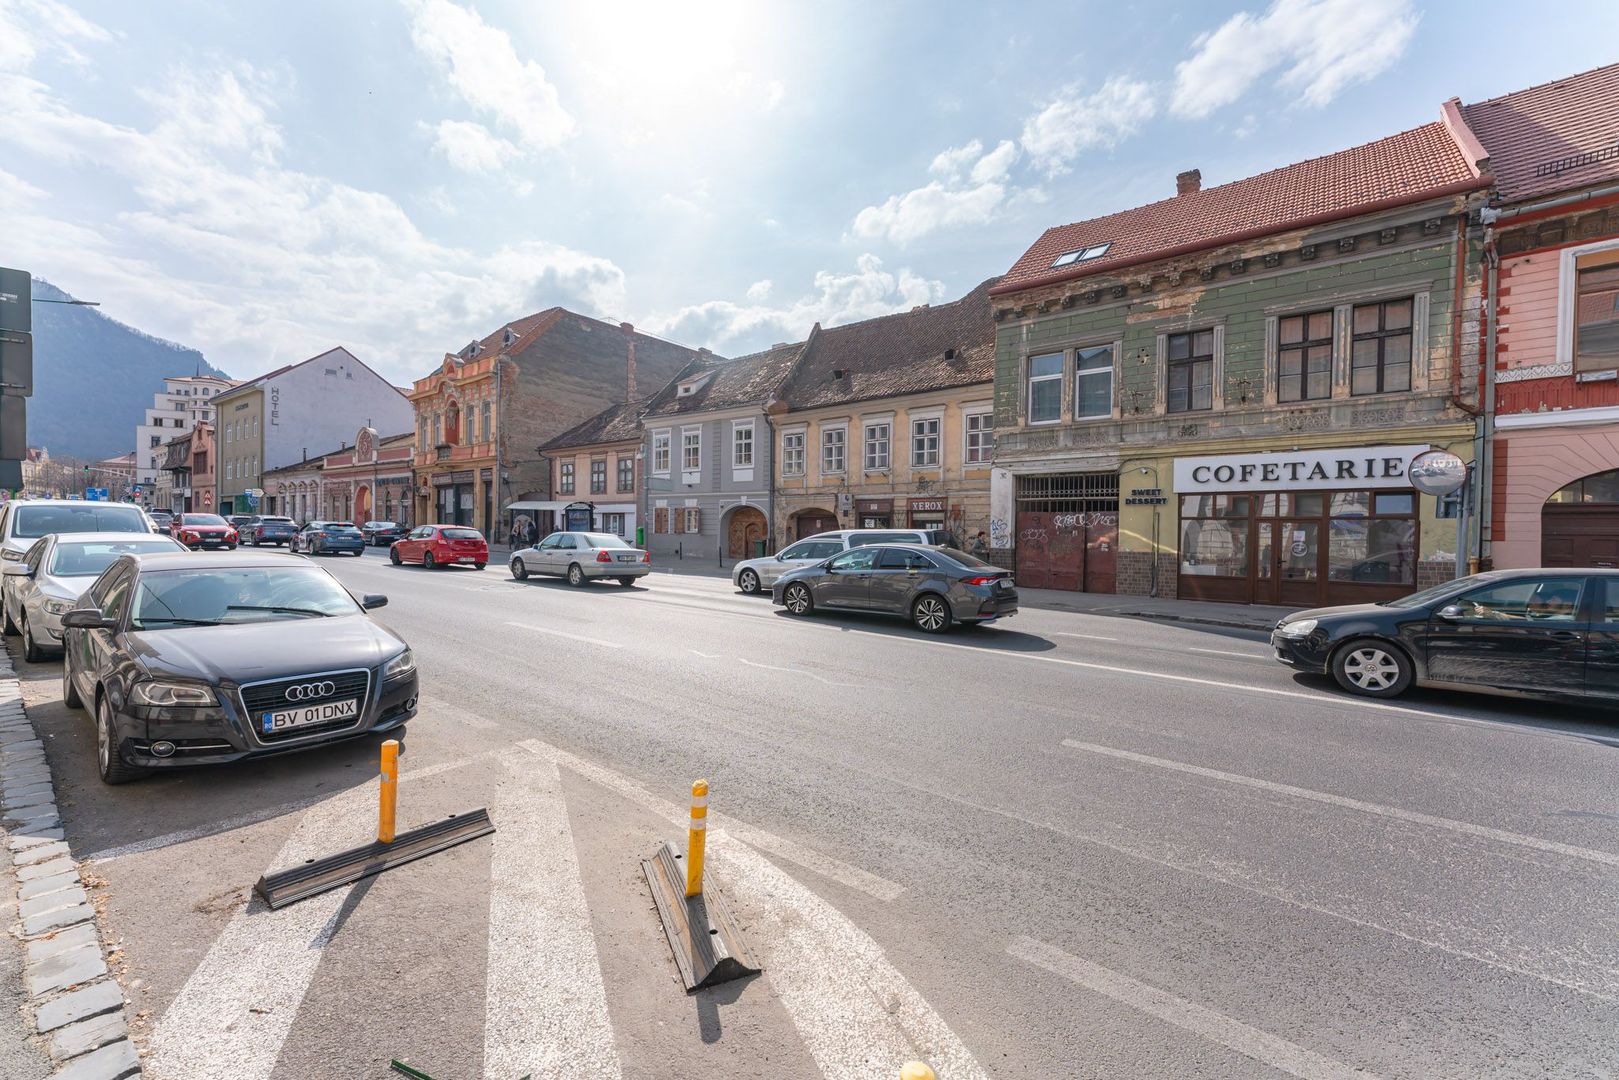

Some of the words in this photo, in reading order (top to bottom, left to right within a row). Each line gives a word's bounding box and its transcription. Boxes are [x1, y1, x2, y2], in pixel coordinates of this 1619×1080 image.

[271, 386, 280, 426] HOTEL
[1192, 457, 1404, 483] COFETARIE
[1131, 488, 1162, 496] SWEET
[912, 501, 943, 511] XEROX
[1125, 497, 1168, 505] DESSERT
[274, 711, 298, 727] BV
